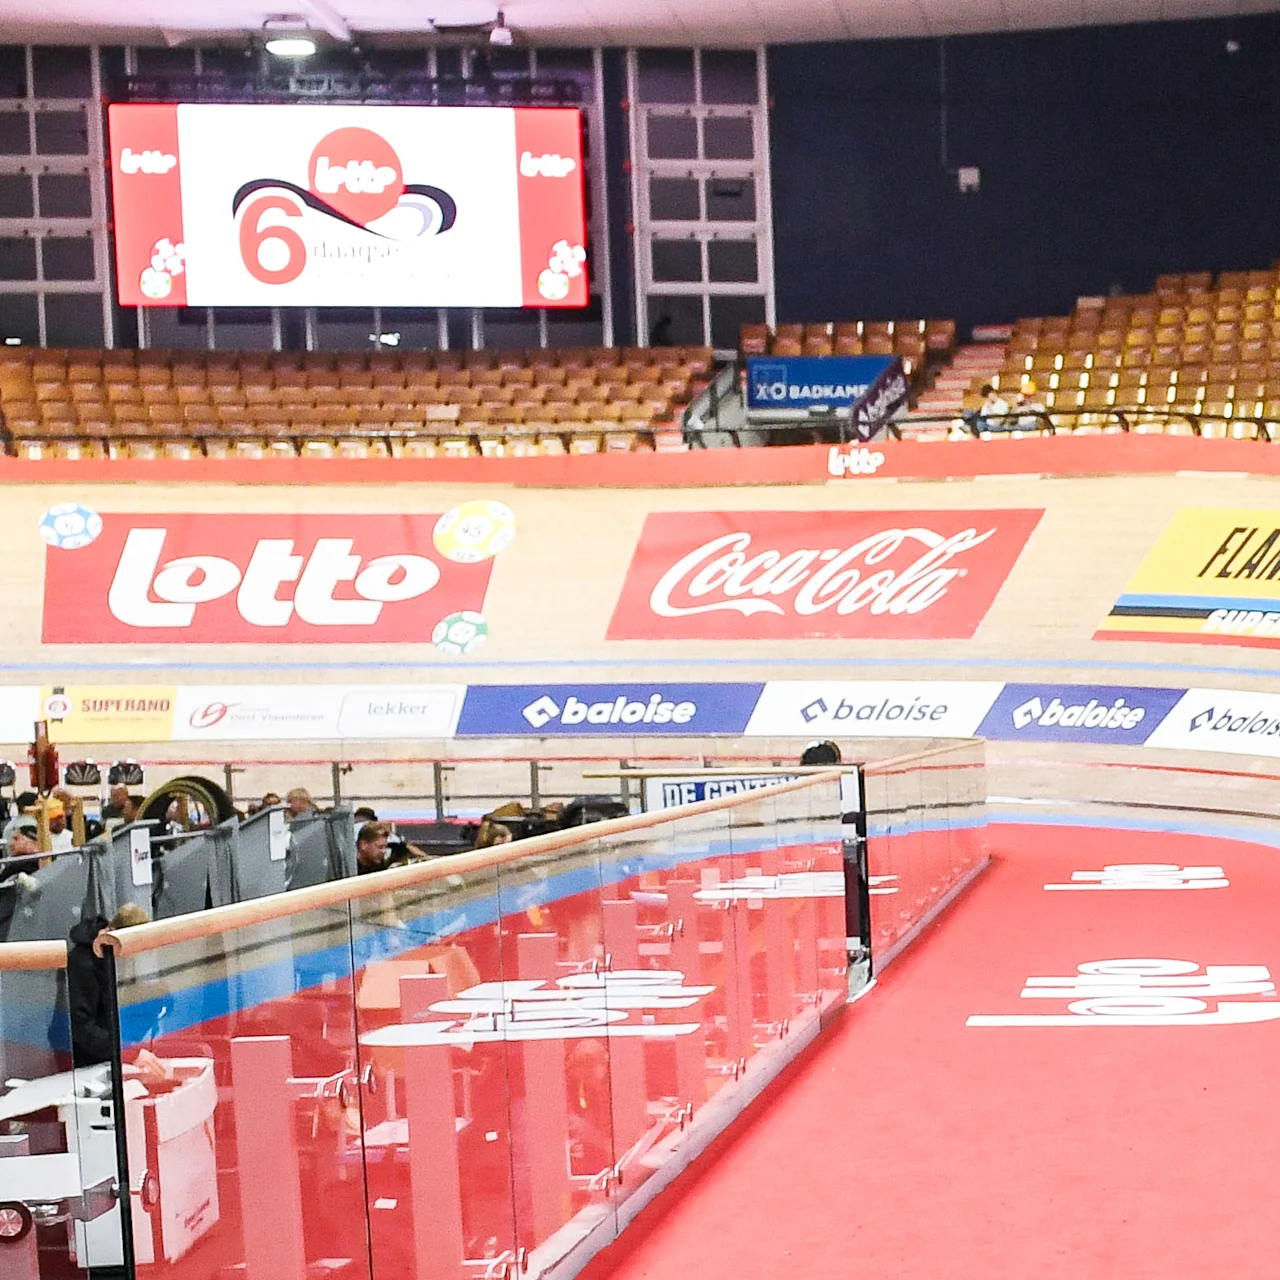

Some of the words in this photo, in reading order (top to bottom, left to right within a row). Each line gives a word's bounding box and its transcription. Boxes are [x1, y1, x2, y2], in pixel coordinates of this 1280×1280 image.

[314, 156, 398, 195] lotto
[239, 195, 307, 285] 6
[828, 446, 885, 477] lotto
[106, 527, 441, 628] lotto
[649, 526, 998, 618] Coca-Cola
[560, 693, 697, 725] baloise
[832, 695, 948, 722] baloise
[1042, 698, 1146, 731] baloise
